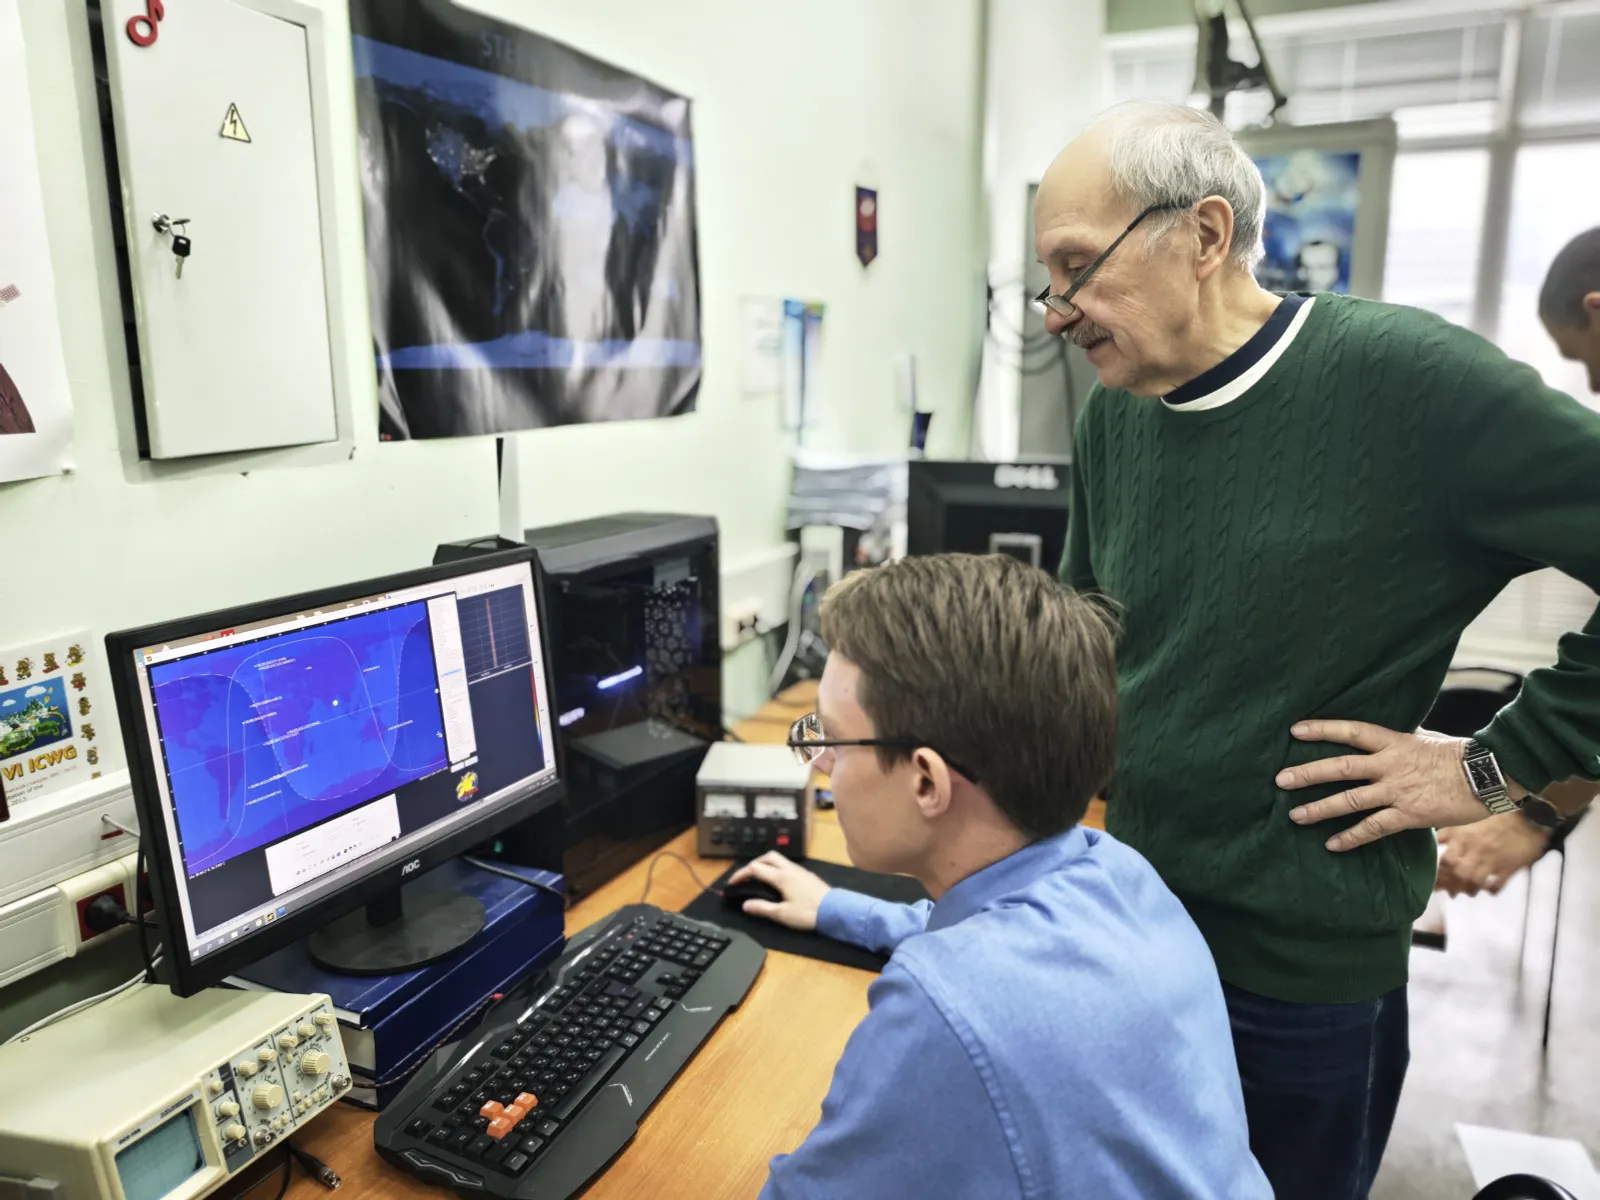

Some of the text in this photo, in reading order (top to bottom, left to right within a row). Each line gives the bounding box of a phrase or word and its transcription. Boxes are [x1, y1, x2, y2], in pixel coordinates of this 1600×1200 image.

[2, 745, 77, 780] VI ICWG
[402, 859, 420, 876] AOC
